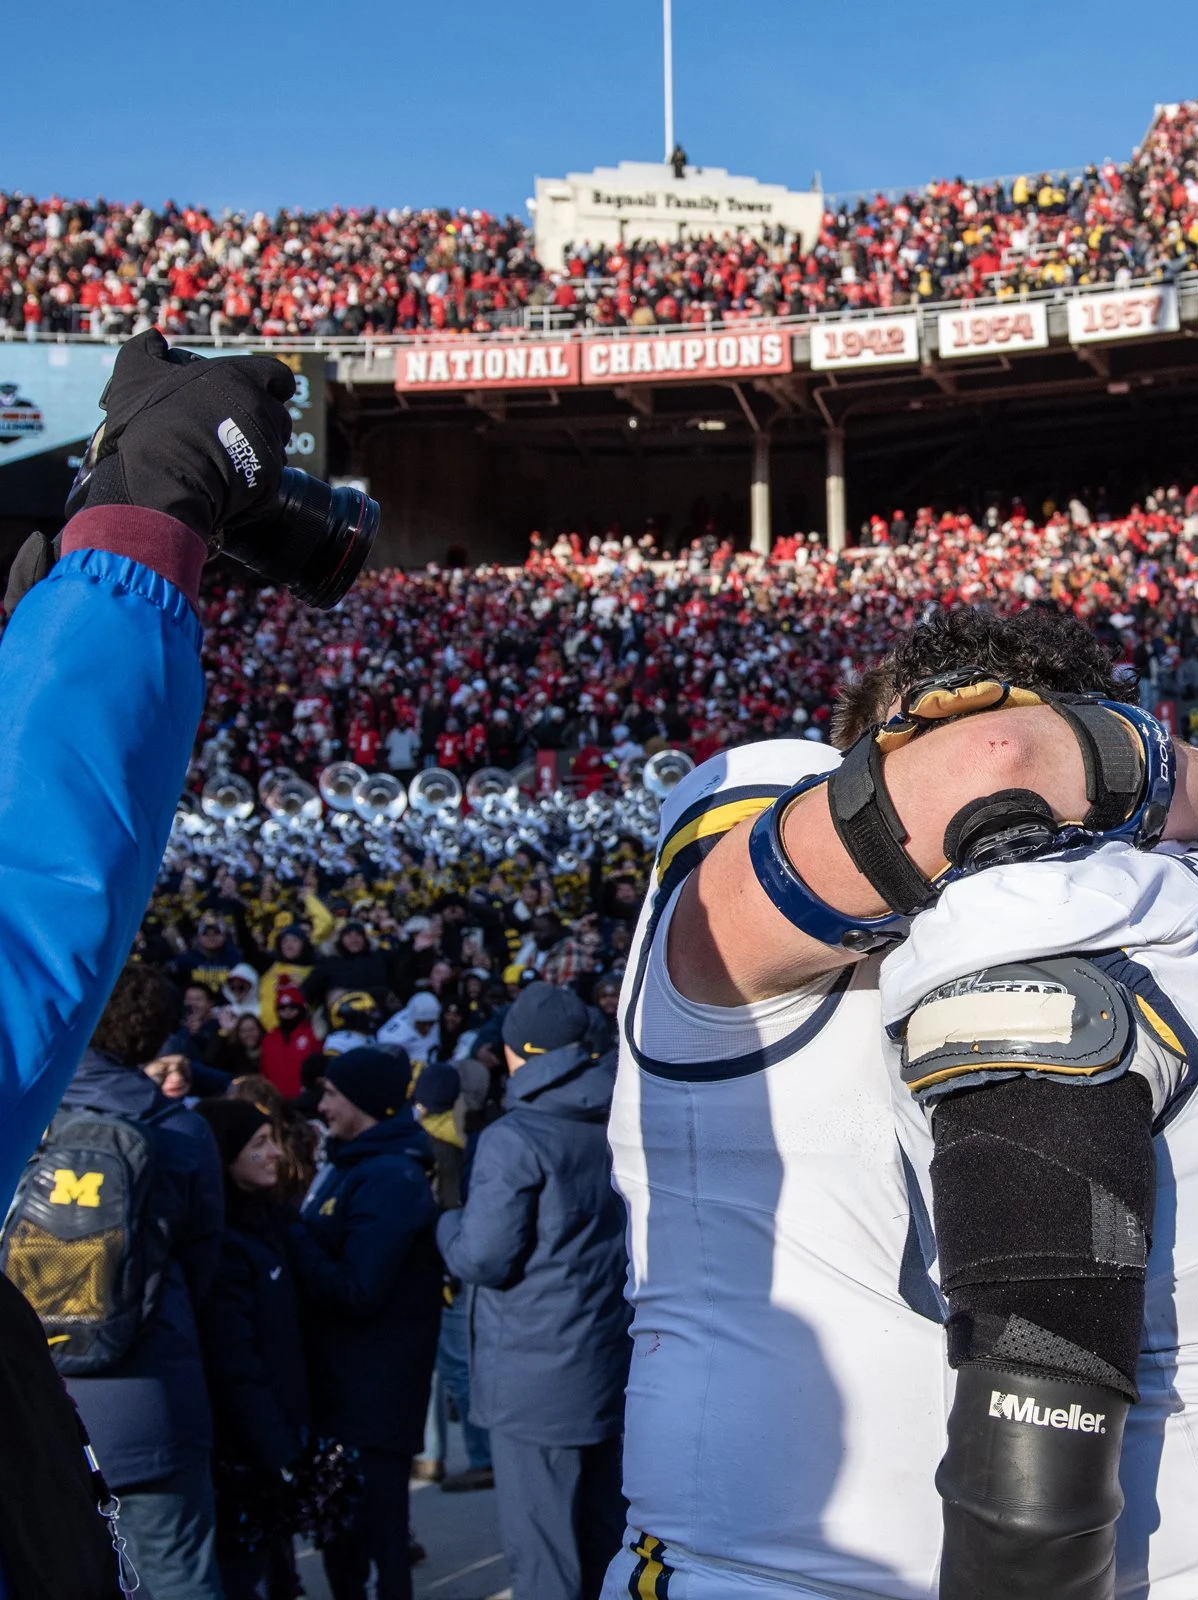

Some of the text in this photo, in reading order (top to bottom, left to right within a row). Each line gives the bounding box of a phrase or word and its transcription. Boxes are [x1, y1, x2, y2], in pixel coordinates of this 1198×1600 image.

[664, 195, 719, 213] Family
[726, 198, 772, 213] Tower
[951, 312, 1034, 348] 1954
[1082, 294, 1162, 333] 1957
[406, 334, 784, 383] NATIONAL CHAMPIONS
[824, 326, 906, 360] 1942
[232, 443, 258, 489] NORTH
[239, 437, 262, 472] FACE
[49, 1168, 105, 1208] M
